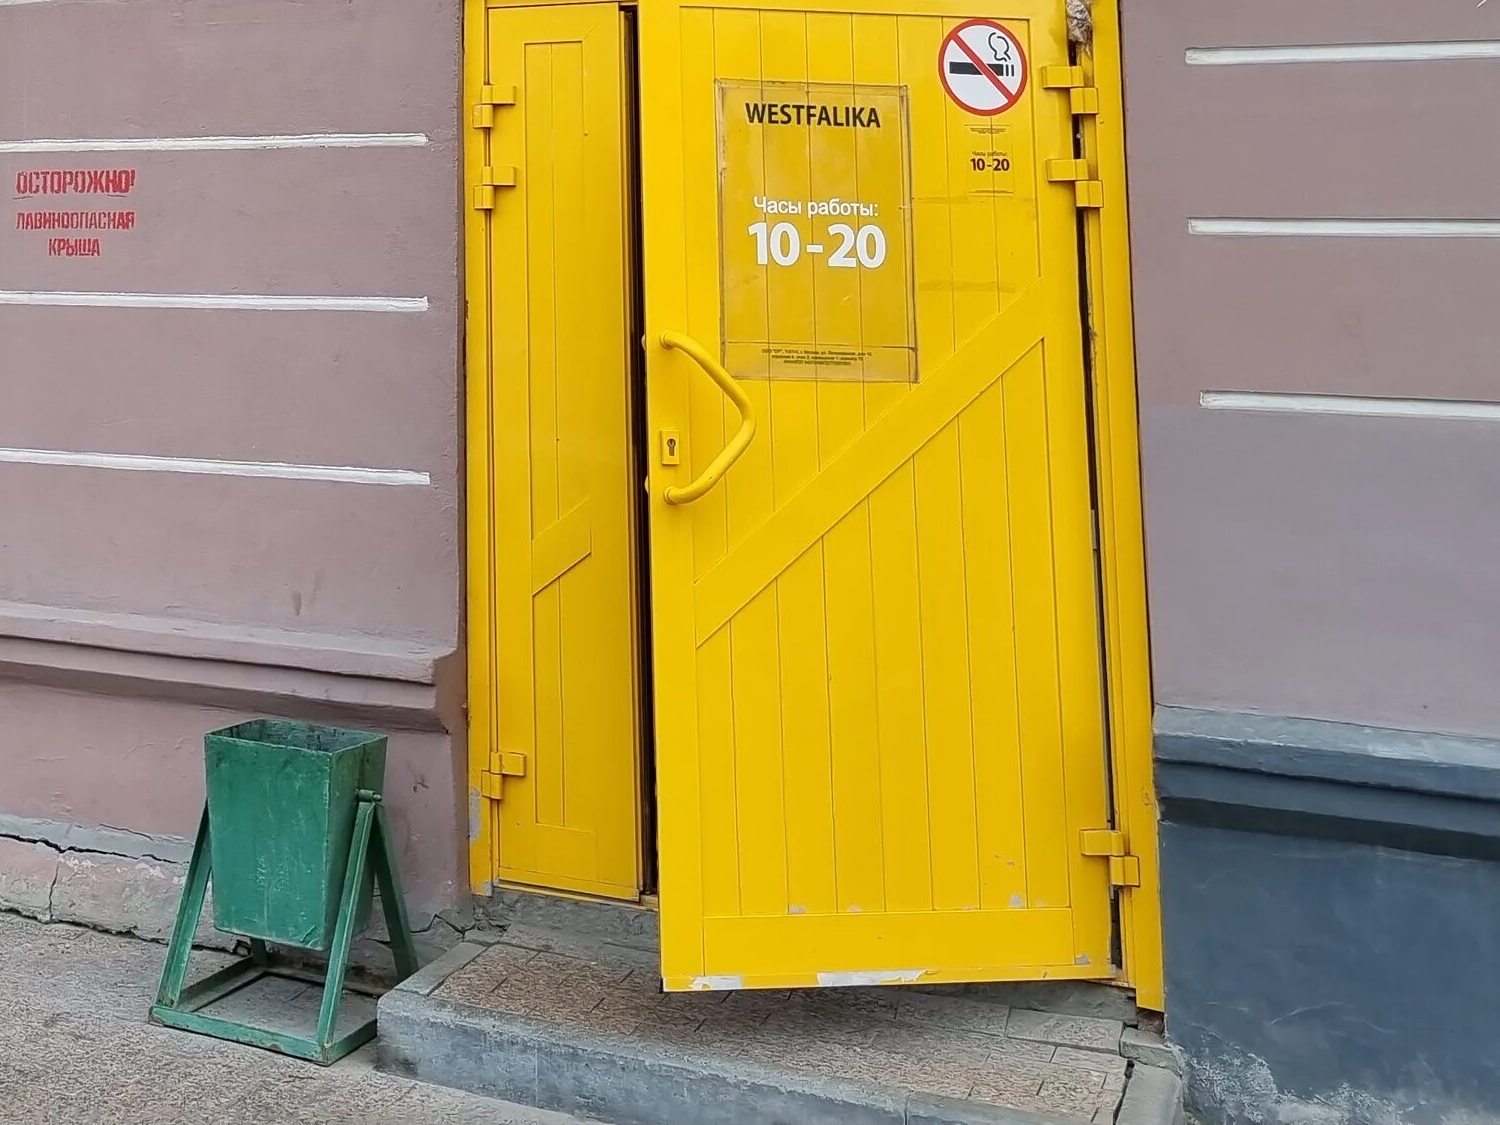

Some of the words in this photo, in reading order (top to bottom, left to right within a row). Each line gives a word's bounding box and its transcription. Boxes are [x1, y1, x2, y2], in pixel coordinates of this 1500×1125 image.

[745, 102, 881, 128] WESTFALIKA
[16, 169, 136, 195] ОСТОРОЖНО!
[753, 195, 801, 215] Часы
[807, 198, 879, 218] работы:
[16, 211, 135, 230] ЛАВИНООПАСНАЯ
[48, 238, 101, 257] КРЫША
